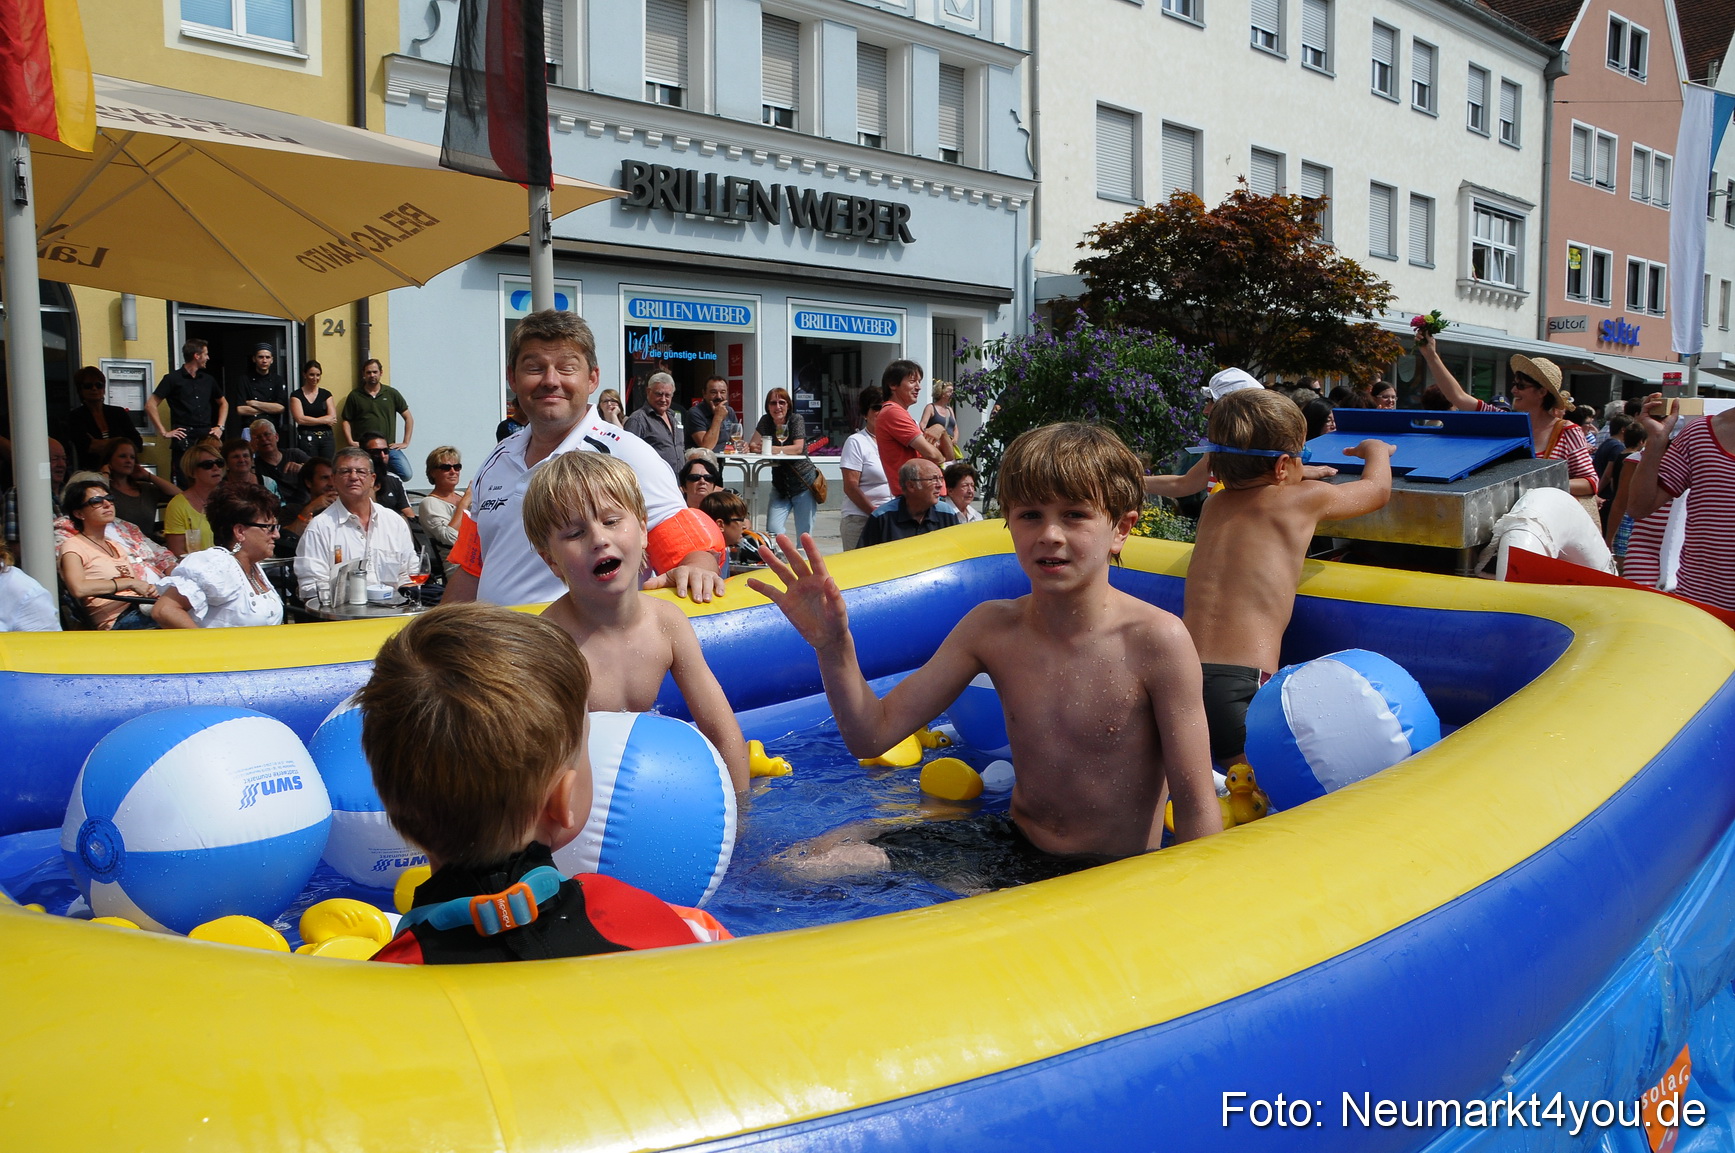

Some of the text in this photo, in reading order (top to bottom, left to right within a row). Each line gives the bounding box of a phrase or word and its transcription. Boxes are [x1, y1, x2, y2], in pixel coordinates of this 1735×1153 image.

[96, 104, 226, 126] rkter
[96, 112, 304, 145] sbräu
[621, 159, 916, 244] BRILLEN WEBER
[636, 299, 746, 324] BRILLEN WEBER
[322, 318, 346, 337] 24
[801, 312, 893, 335] BRILLEN WEBER
[628, 322, 665, 360] light
[650, 349, 662, 358] die
[663, 350, 697, 361] günstige
[698, 351, 717, 360] Linie
[243, 773, 272, 784] neumarkt
[260, 775, 303, 796] swn
[394, 854, 430, 868] wn
[497, 898, 512, 928] nabaiji
